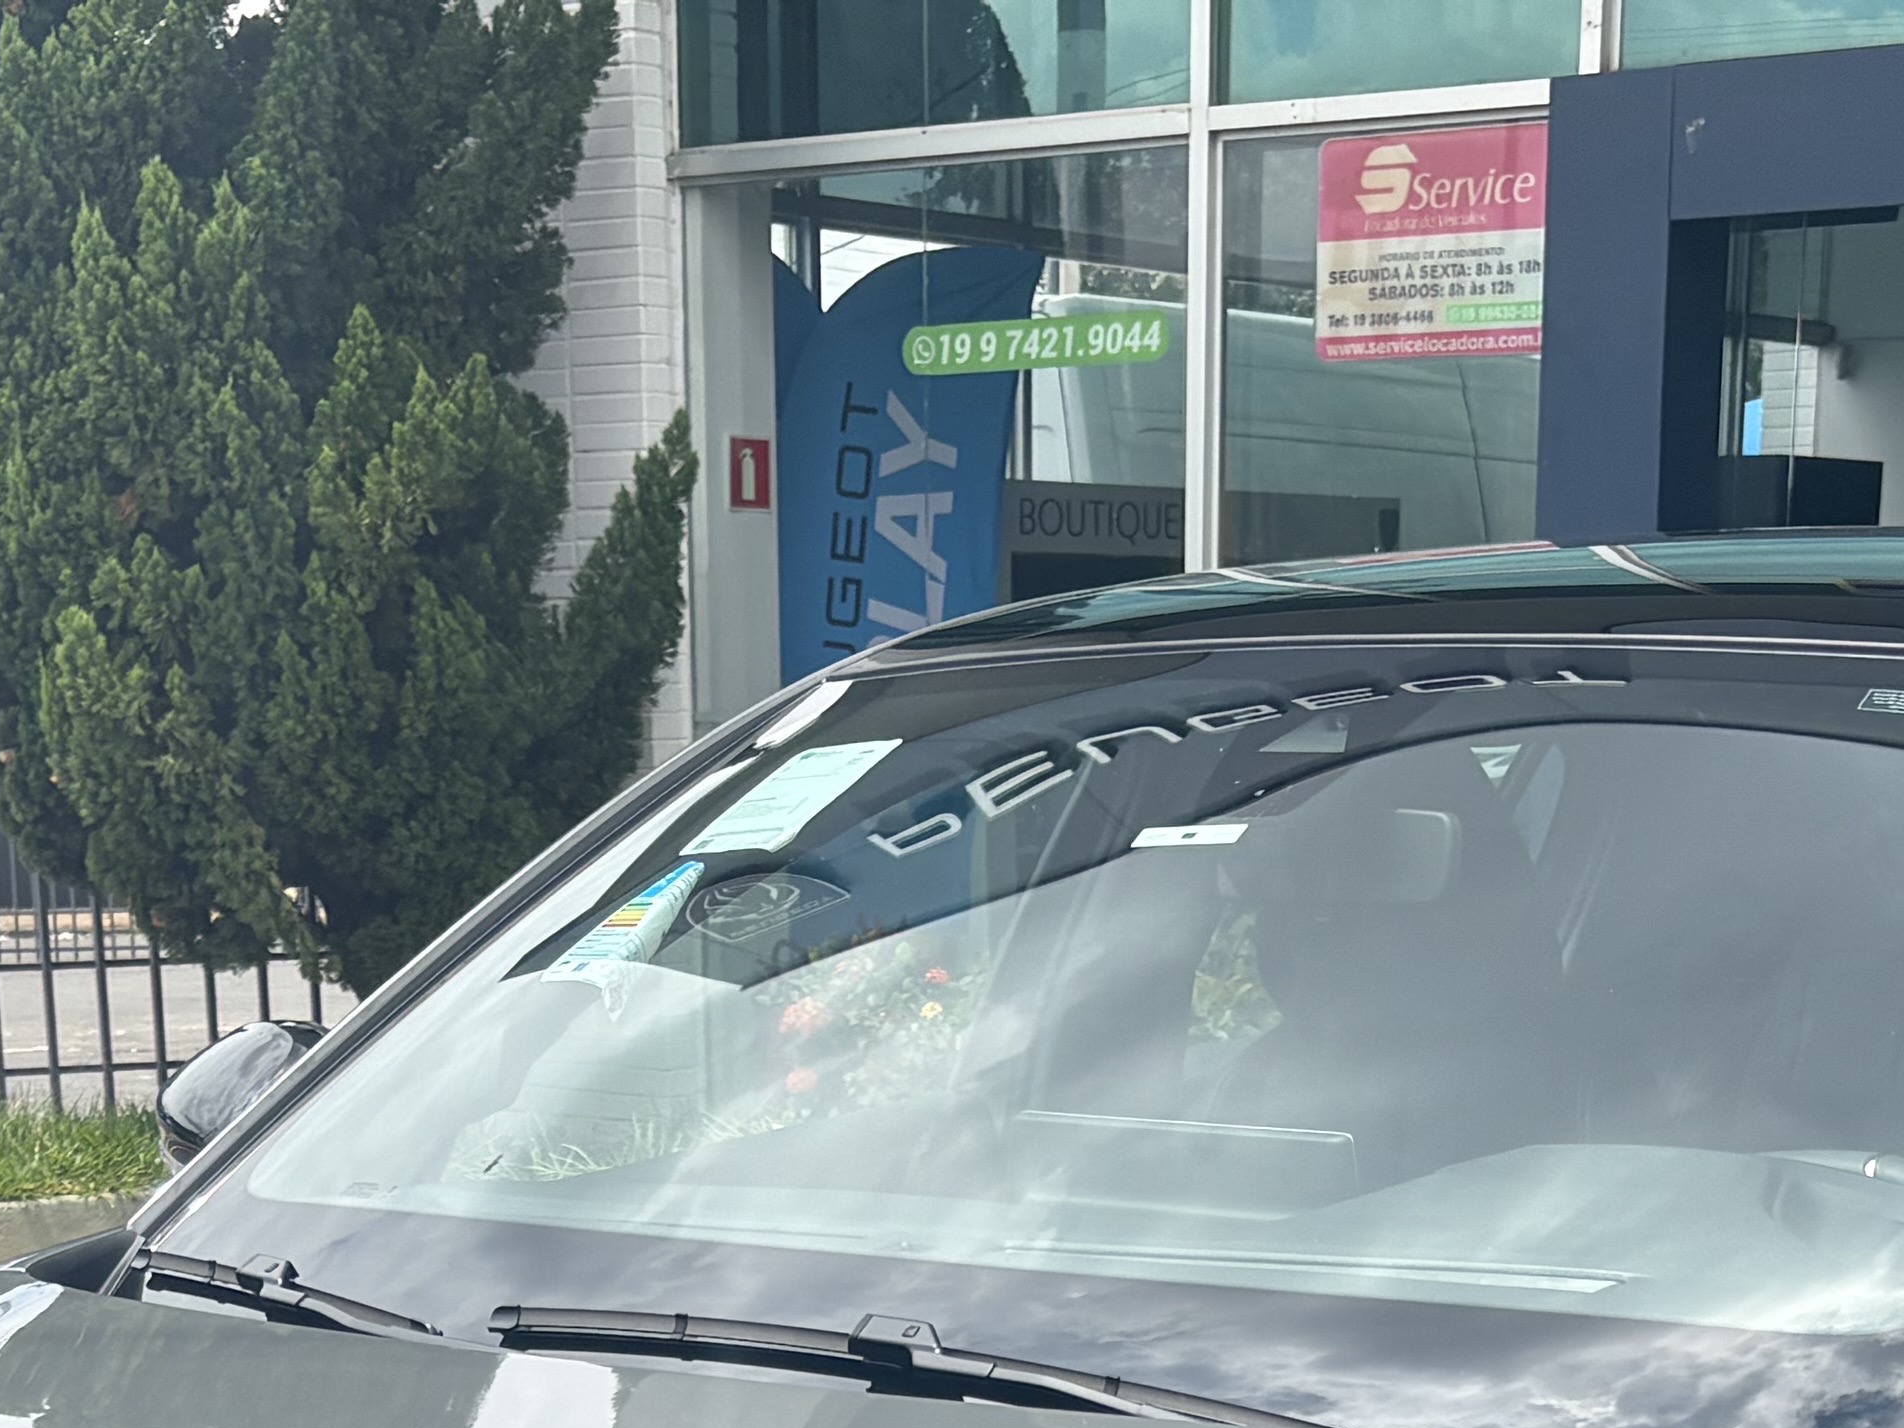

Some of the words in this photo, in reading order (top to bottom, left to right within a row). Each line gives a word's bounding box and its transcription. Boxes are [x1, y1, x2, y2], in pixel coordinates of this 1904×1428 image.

[1408, 168, 1536, 211] Service
[1328, 268, 1400, 285] SEGUNDA
[1419, 263, 1472, 280] SEXTA:
[1475, 262, 1493, 277] 8h
[1518, 259, 1541, 274] 18h
[1448, 283, 1465, 297] 8h
[1490, 279, 1515, 295] 12h
[1327, 314, 1349, 328] Tel:
[1353, 313, 1366, 326] 19
[939, 333, 971, 365] 19
[980, 331, 997, 362] 9
[1006, 320, 1161, 361] 7421.9044
[1019, 498, 1180, 545] BOUTIQUE
